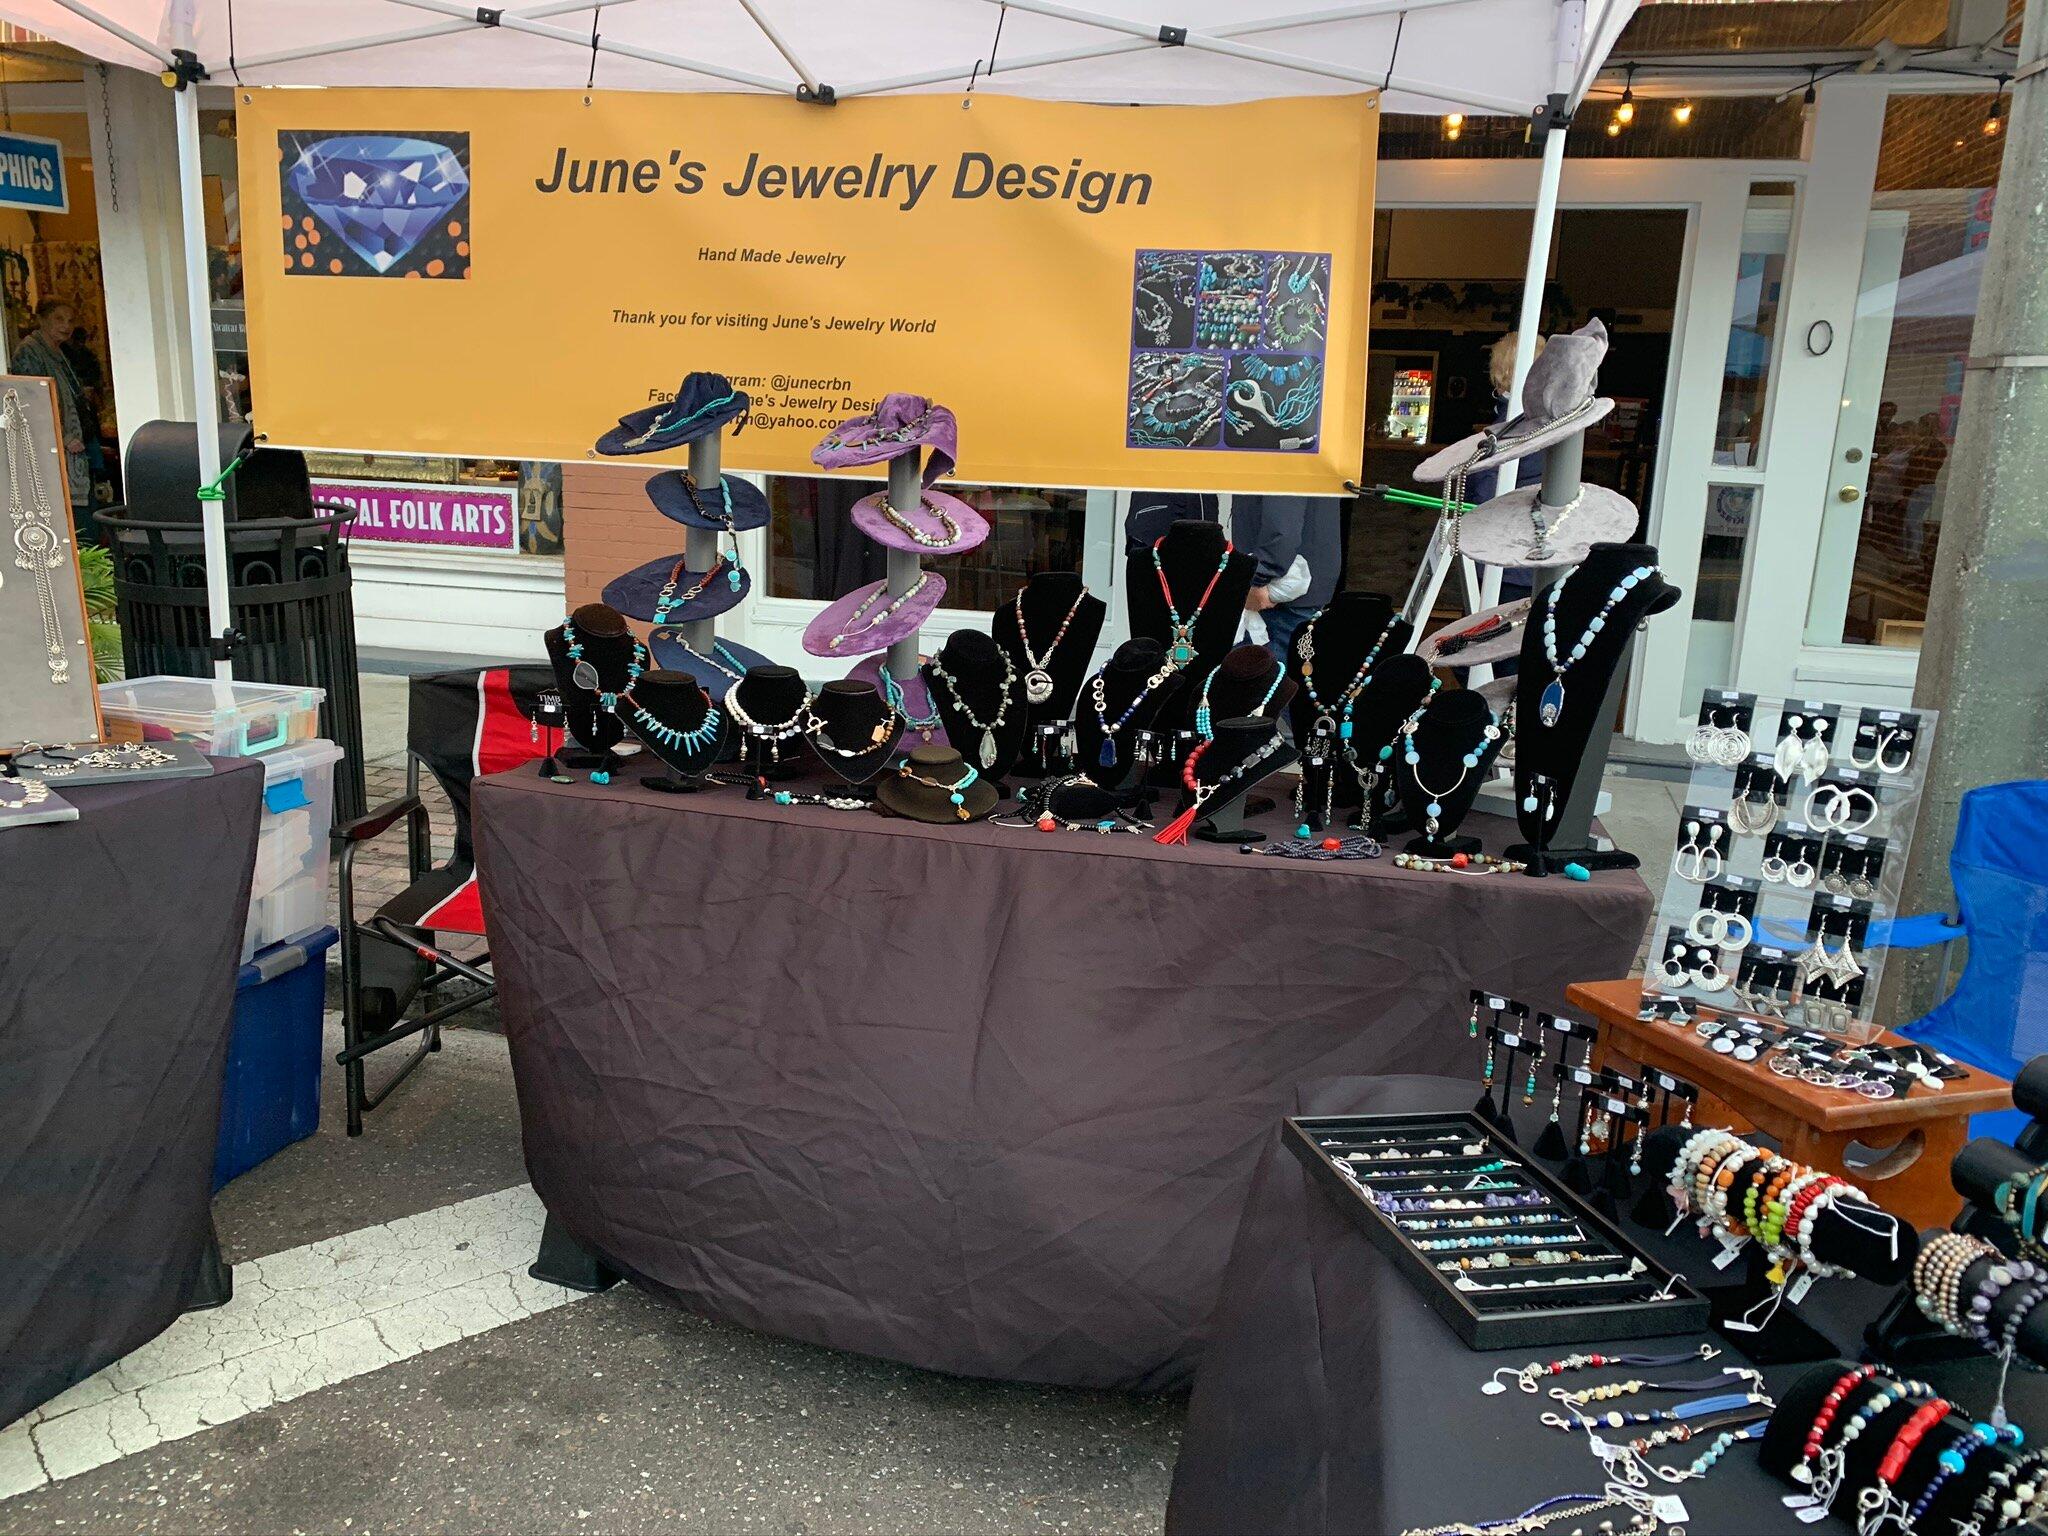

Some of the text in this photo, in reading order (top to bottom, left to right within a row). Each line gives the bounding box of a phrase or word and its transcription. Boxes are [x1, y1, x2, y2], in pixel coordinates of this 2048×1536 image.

[0, 151, 54, 192] PHICS
[535, 147, 1153, 214] June's Jewelry Design
[698, 247, 846, 269] Hand Made Jewelry
[612, 309, 937, 335] Thank you for visiting June's Jewelry World
[770, 374, 852, 392] @junecrbn
[779, 394, 838, 413] Jewelry
[389, 499, 444, 531] FOLK
[451, 502, 507, 536] ARTS
